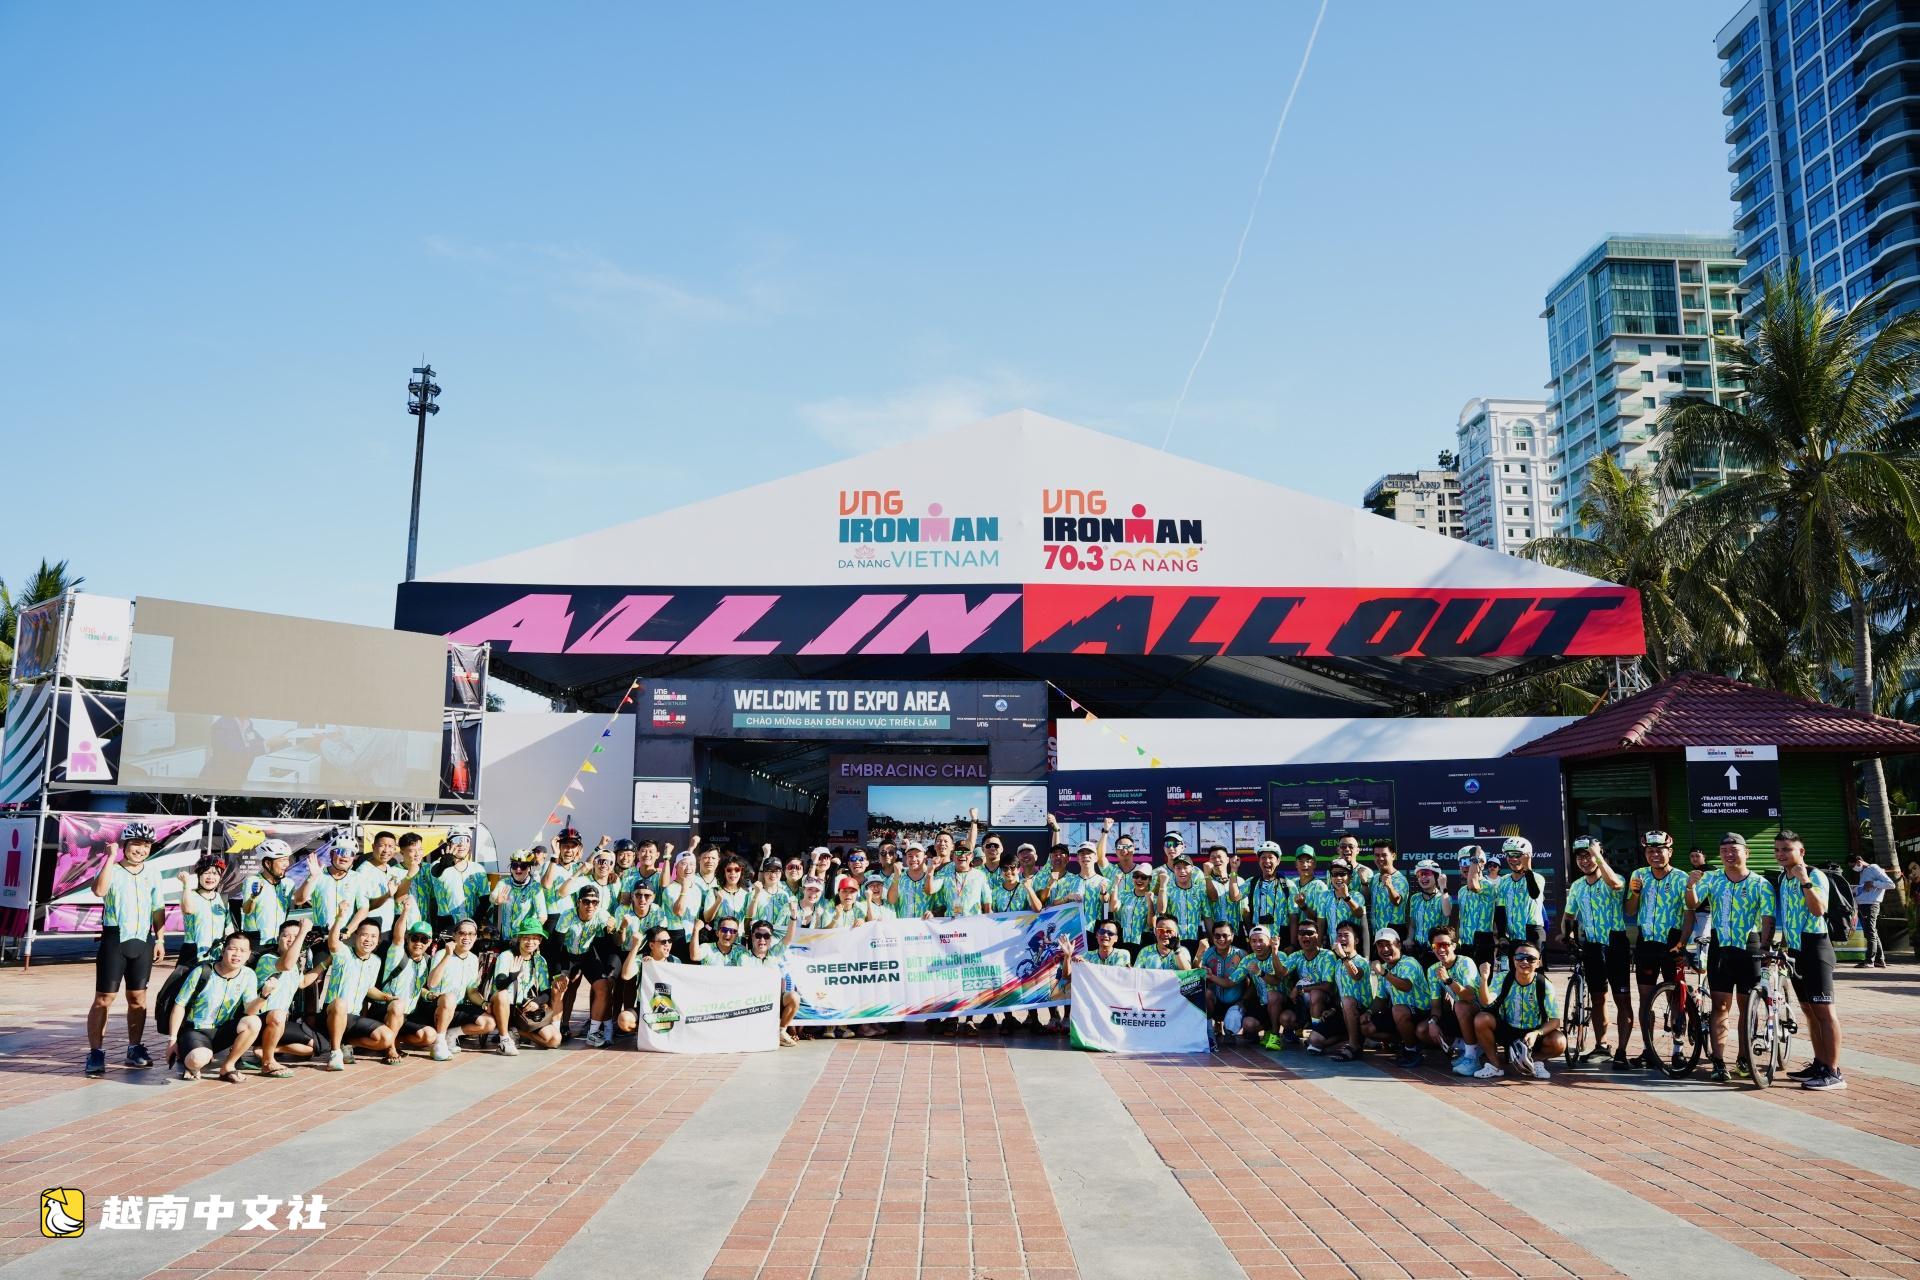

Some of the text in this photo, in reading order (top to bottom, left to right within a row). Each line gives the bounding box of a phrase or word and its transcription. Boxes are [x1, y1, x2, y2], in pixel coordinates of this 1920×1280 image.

[839, 490, 903, 516] VNG
[1043, 489, 1107, 515] VNG
[839, 502, 999, 543] IRONMAN
[1043, 503, 1202, 544] IRONMAN
[838, 550, 999, 569] DA NANG VIETNAM
[1043, 545, 1199, 573] 70.3 DA NANG
[448, 593, 1023, 655] ALL IN
[1026, 594, 1625, 656] ALL OUT
[733, 689, 951, 712] WELCOME TO EXPO AREA
[746, 713, 937, 728] CHÀO MỪNG BẠN ĐẾN KHU VỰC TRIỂN LÃM
[841, 763, 986, 778] EMBRACING CHAL
[1402, 852, 1435, 861] EVENT
[939, 931, 967, 939] IRONMAN
[806, 960, 899, 974] GREENFEED
[961, 965, 1001, 979] IRONMAN
[824, 973, 900, 986] IRONMAN
[1110, 1011, 1166, 1027] GREENFEED
